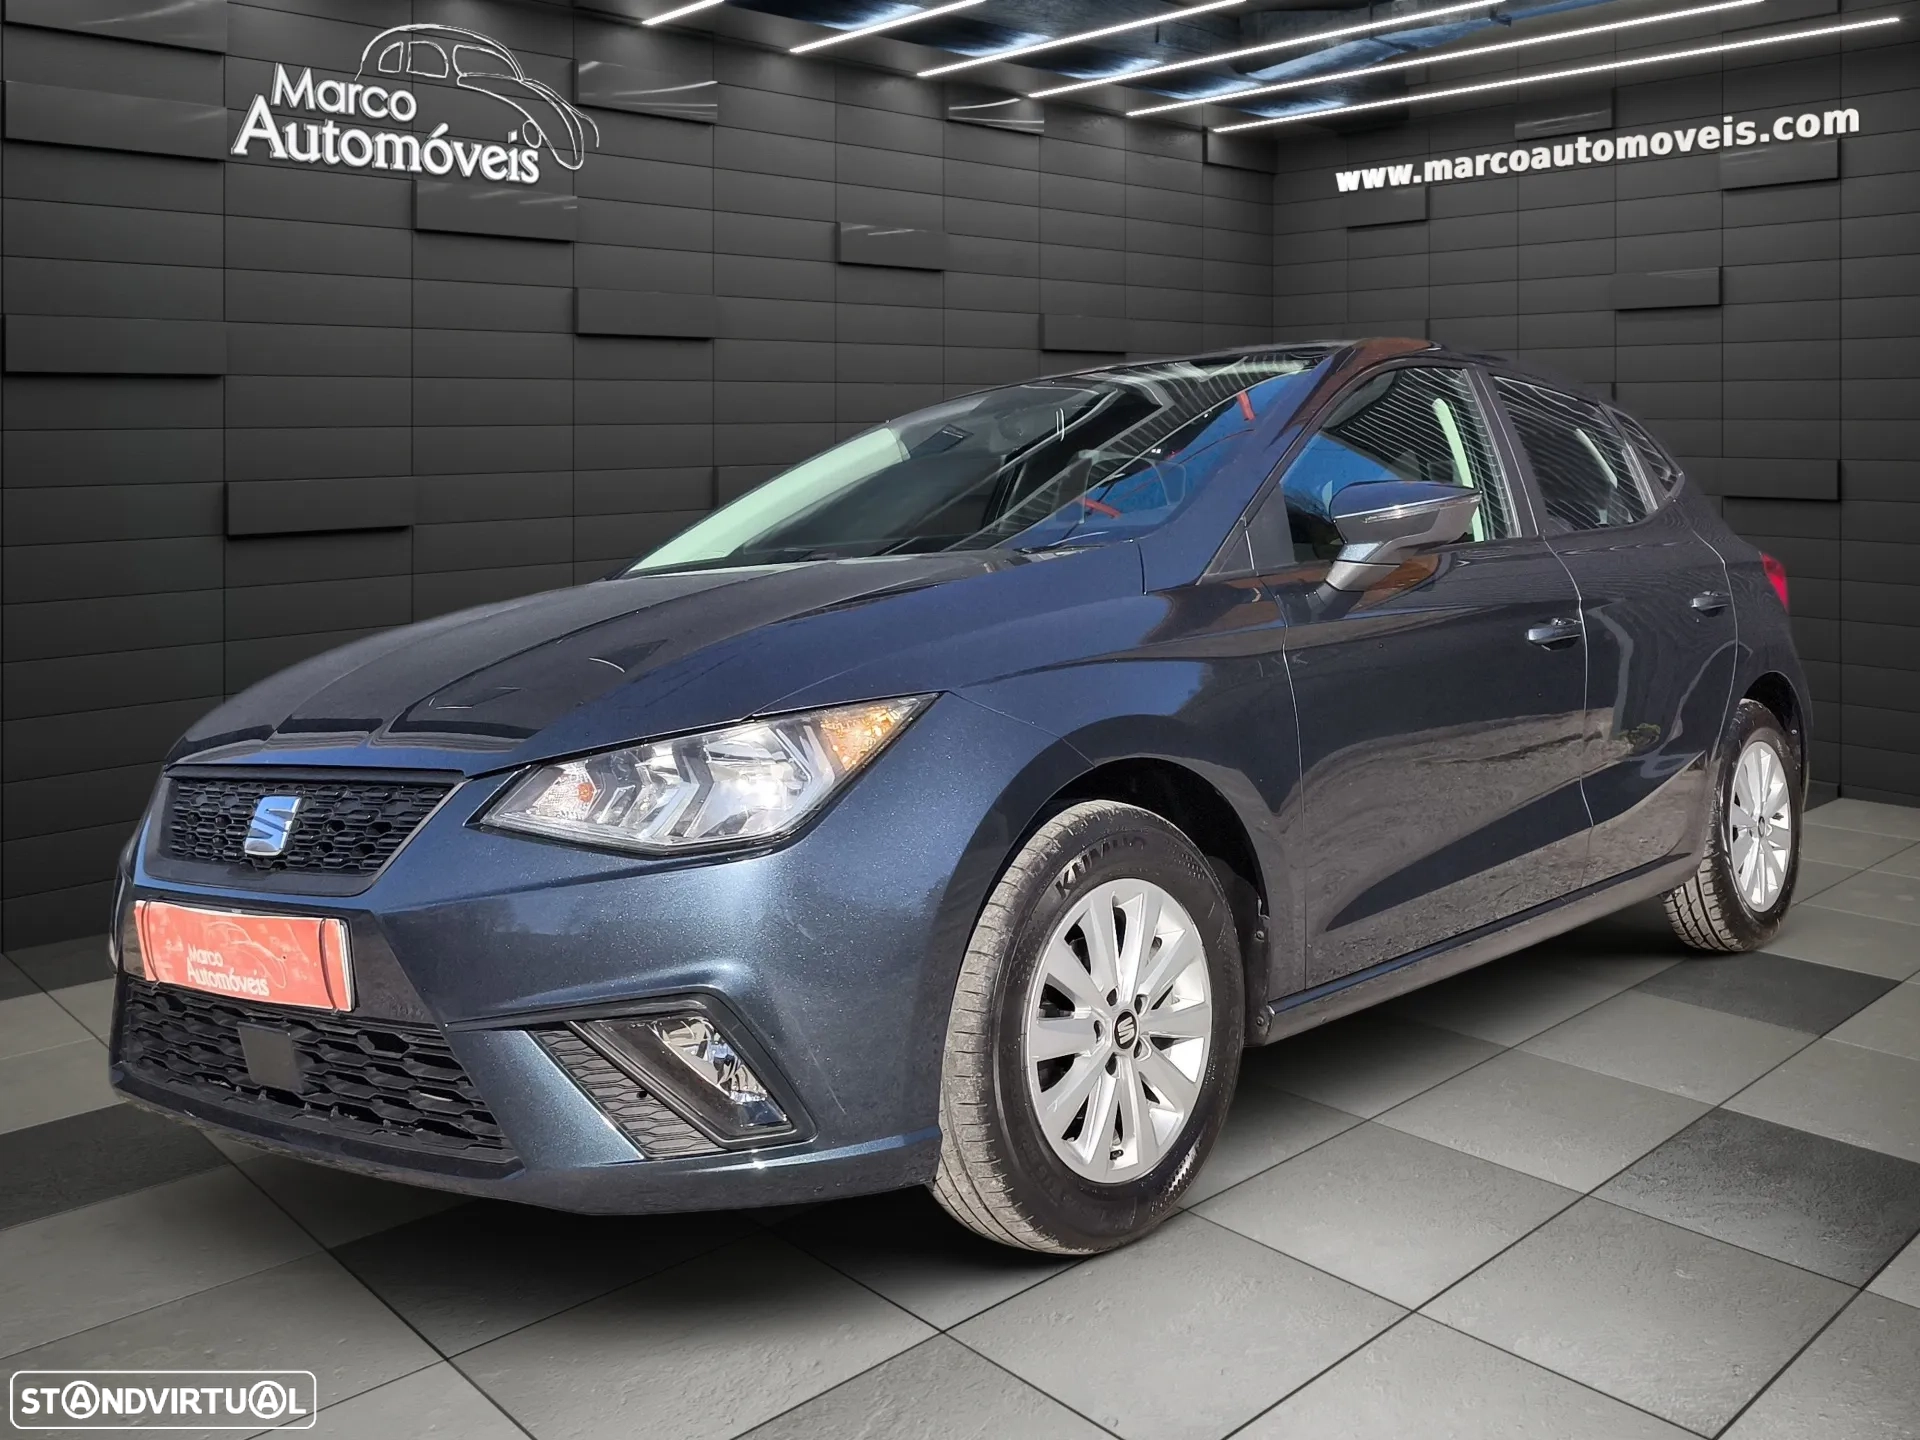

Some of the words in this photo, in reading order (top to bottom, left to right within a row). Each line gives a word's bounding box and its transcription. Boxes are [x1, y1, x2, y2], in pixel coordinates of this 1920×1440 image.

[270, 62, 418, 122] Marco
[231, 93, 541, 185] Automóveis
[1335, 107, 1860, 193] www.marcoautomoveis.com
[187, 943, 223, 967] Marco
